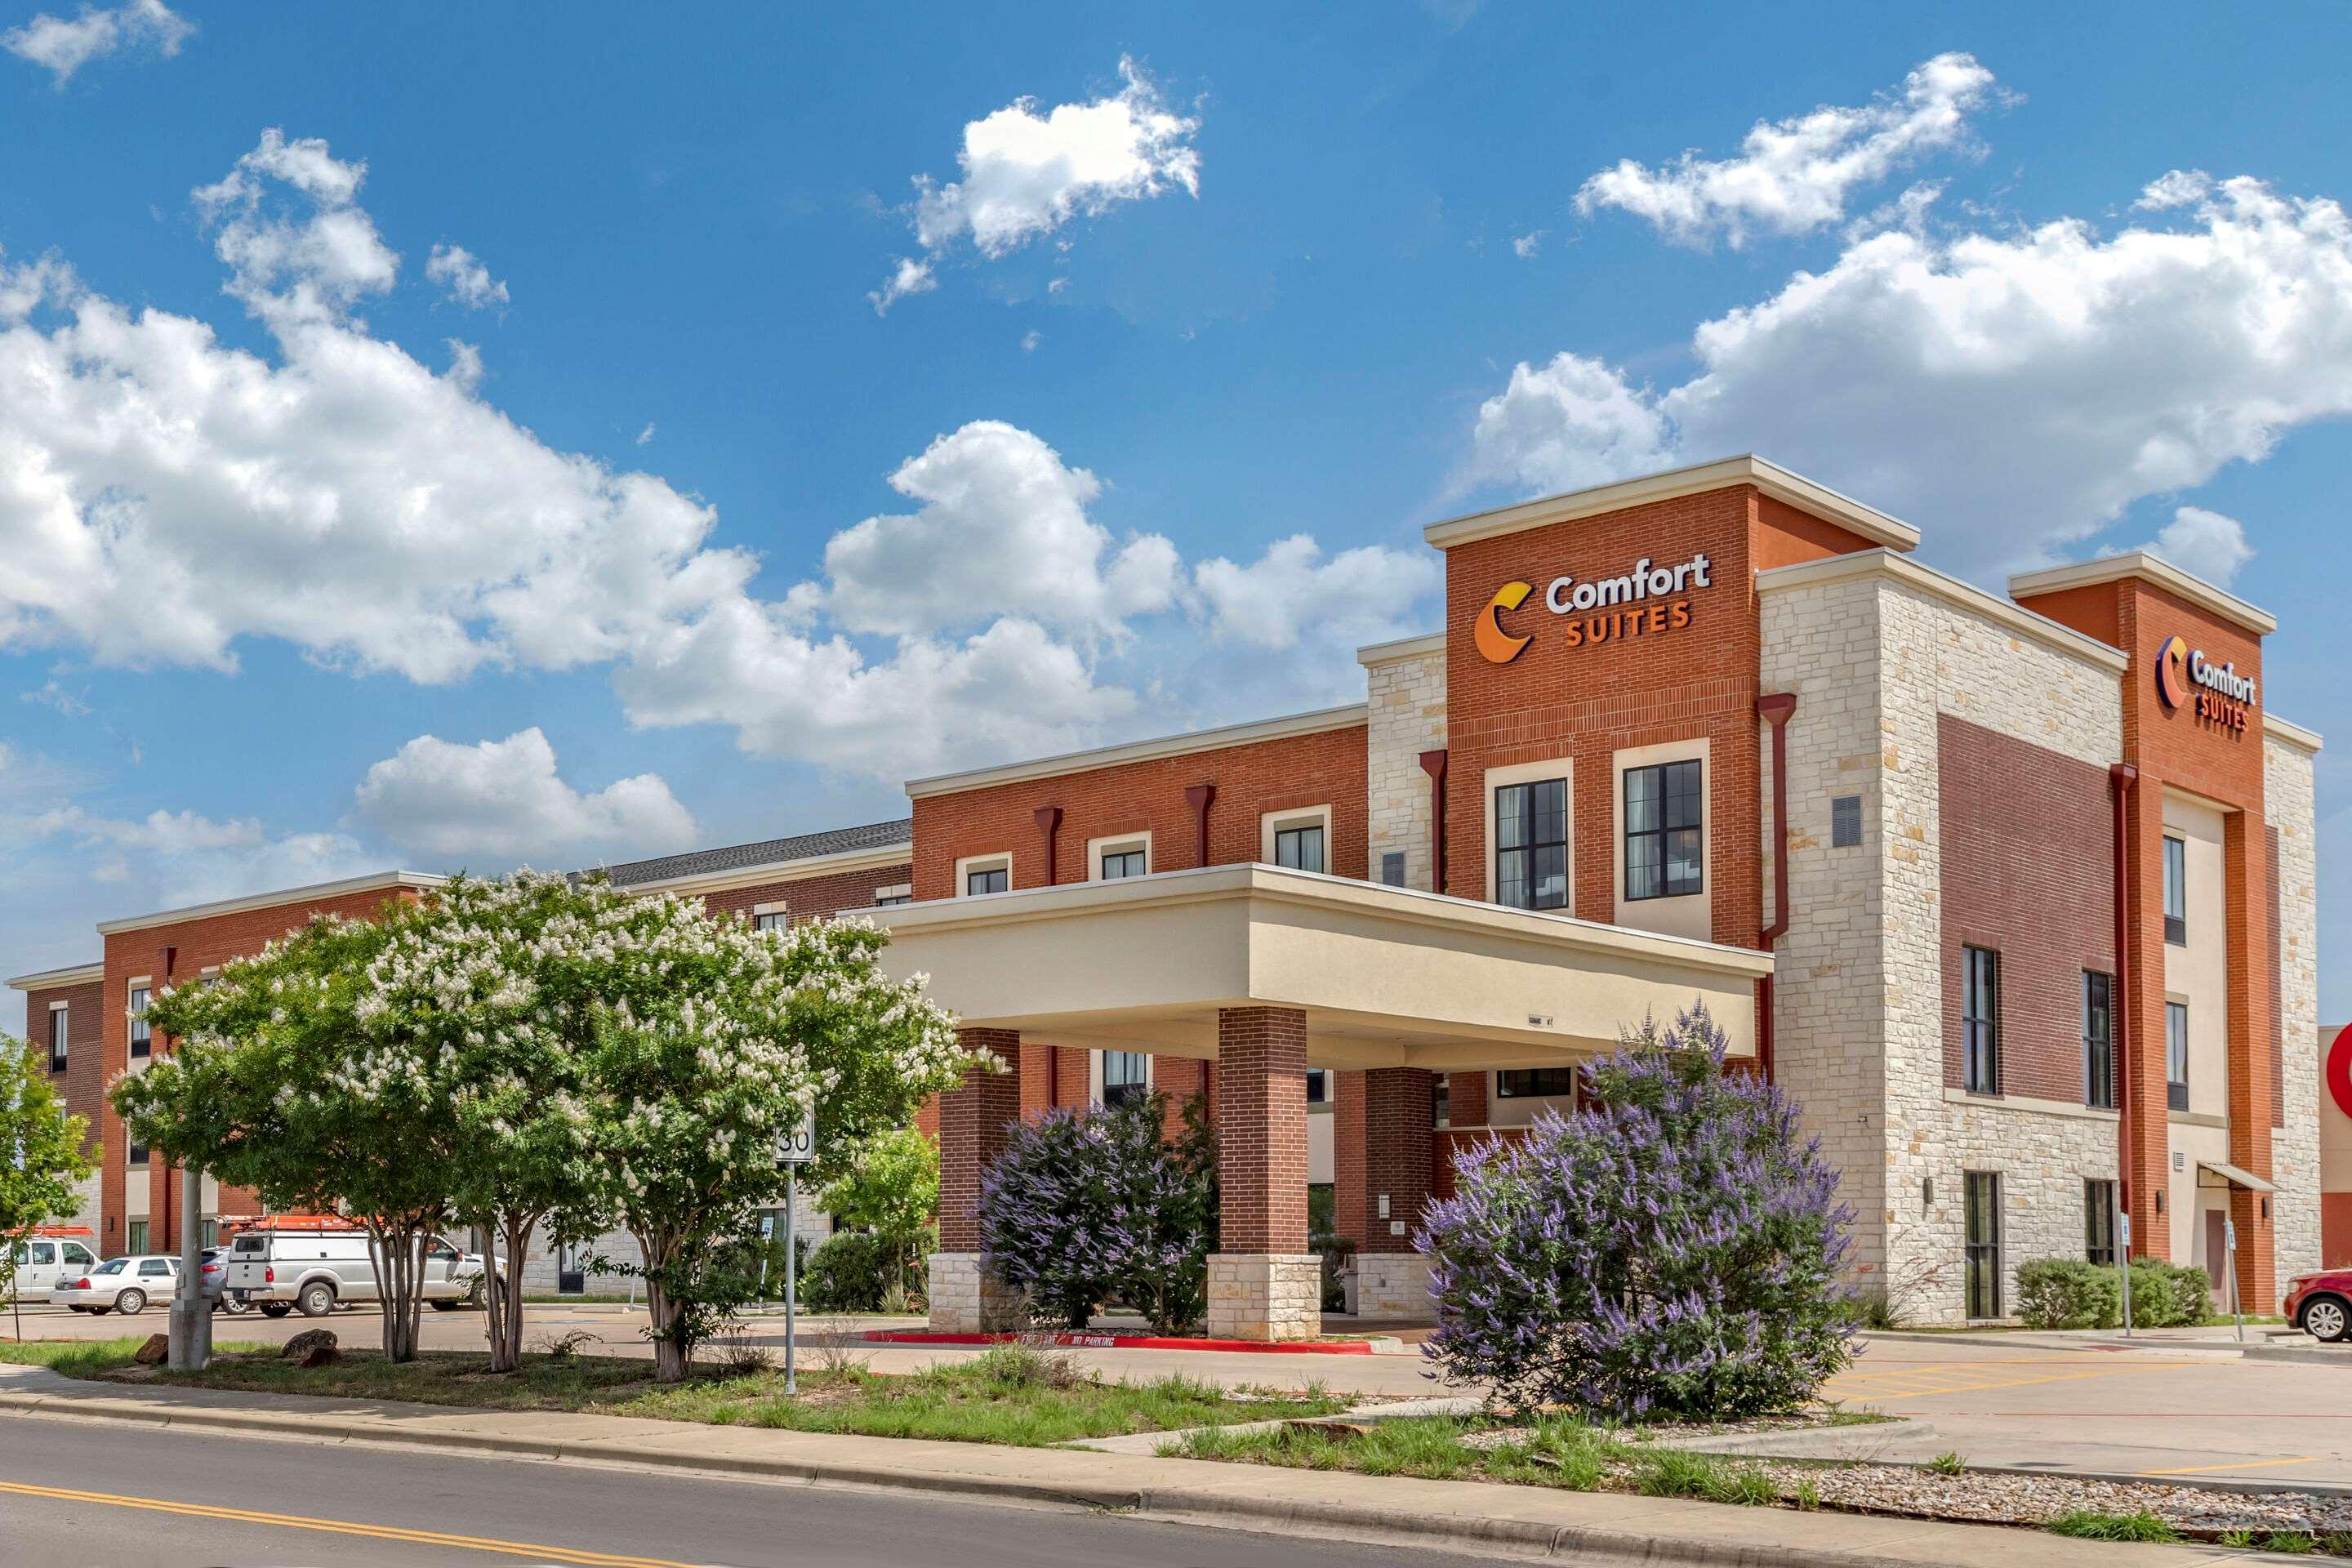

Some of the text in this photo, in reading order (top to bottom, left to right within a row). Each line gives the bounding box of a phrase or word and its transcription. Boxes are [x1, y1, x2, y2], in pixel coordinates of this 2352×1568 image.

[1545, 554, 1711, 615] Comfort
[1566, 600, 1691, 648] SUITES
[2189, 649, 2256, 706] Comfort
[2198, 693, 2250, 733] SUITES
[777, 1129, 809, 1152] 30
[1071, 1335, 1083, 1345] NO
[1084, 1336, 1115, 1347] PARKING
